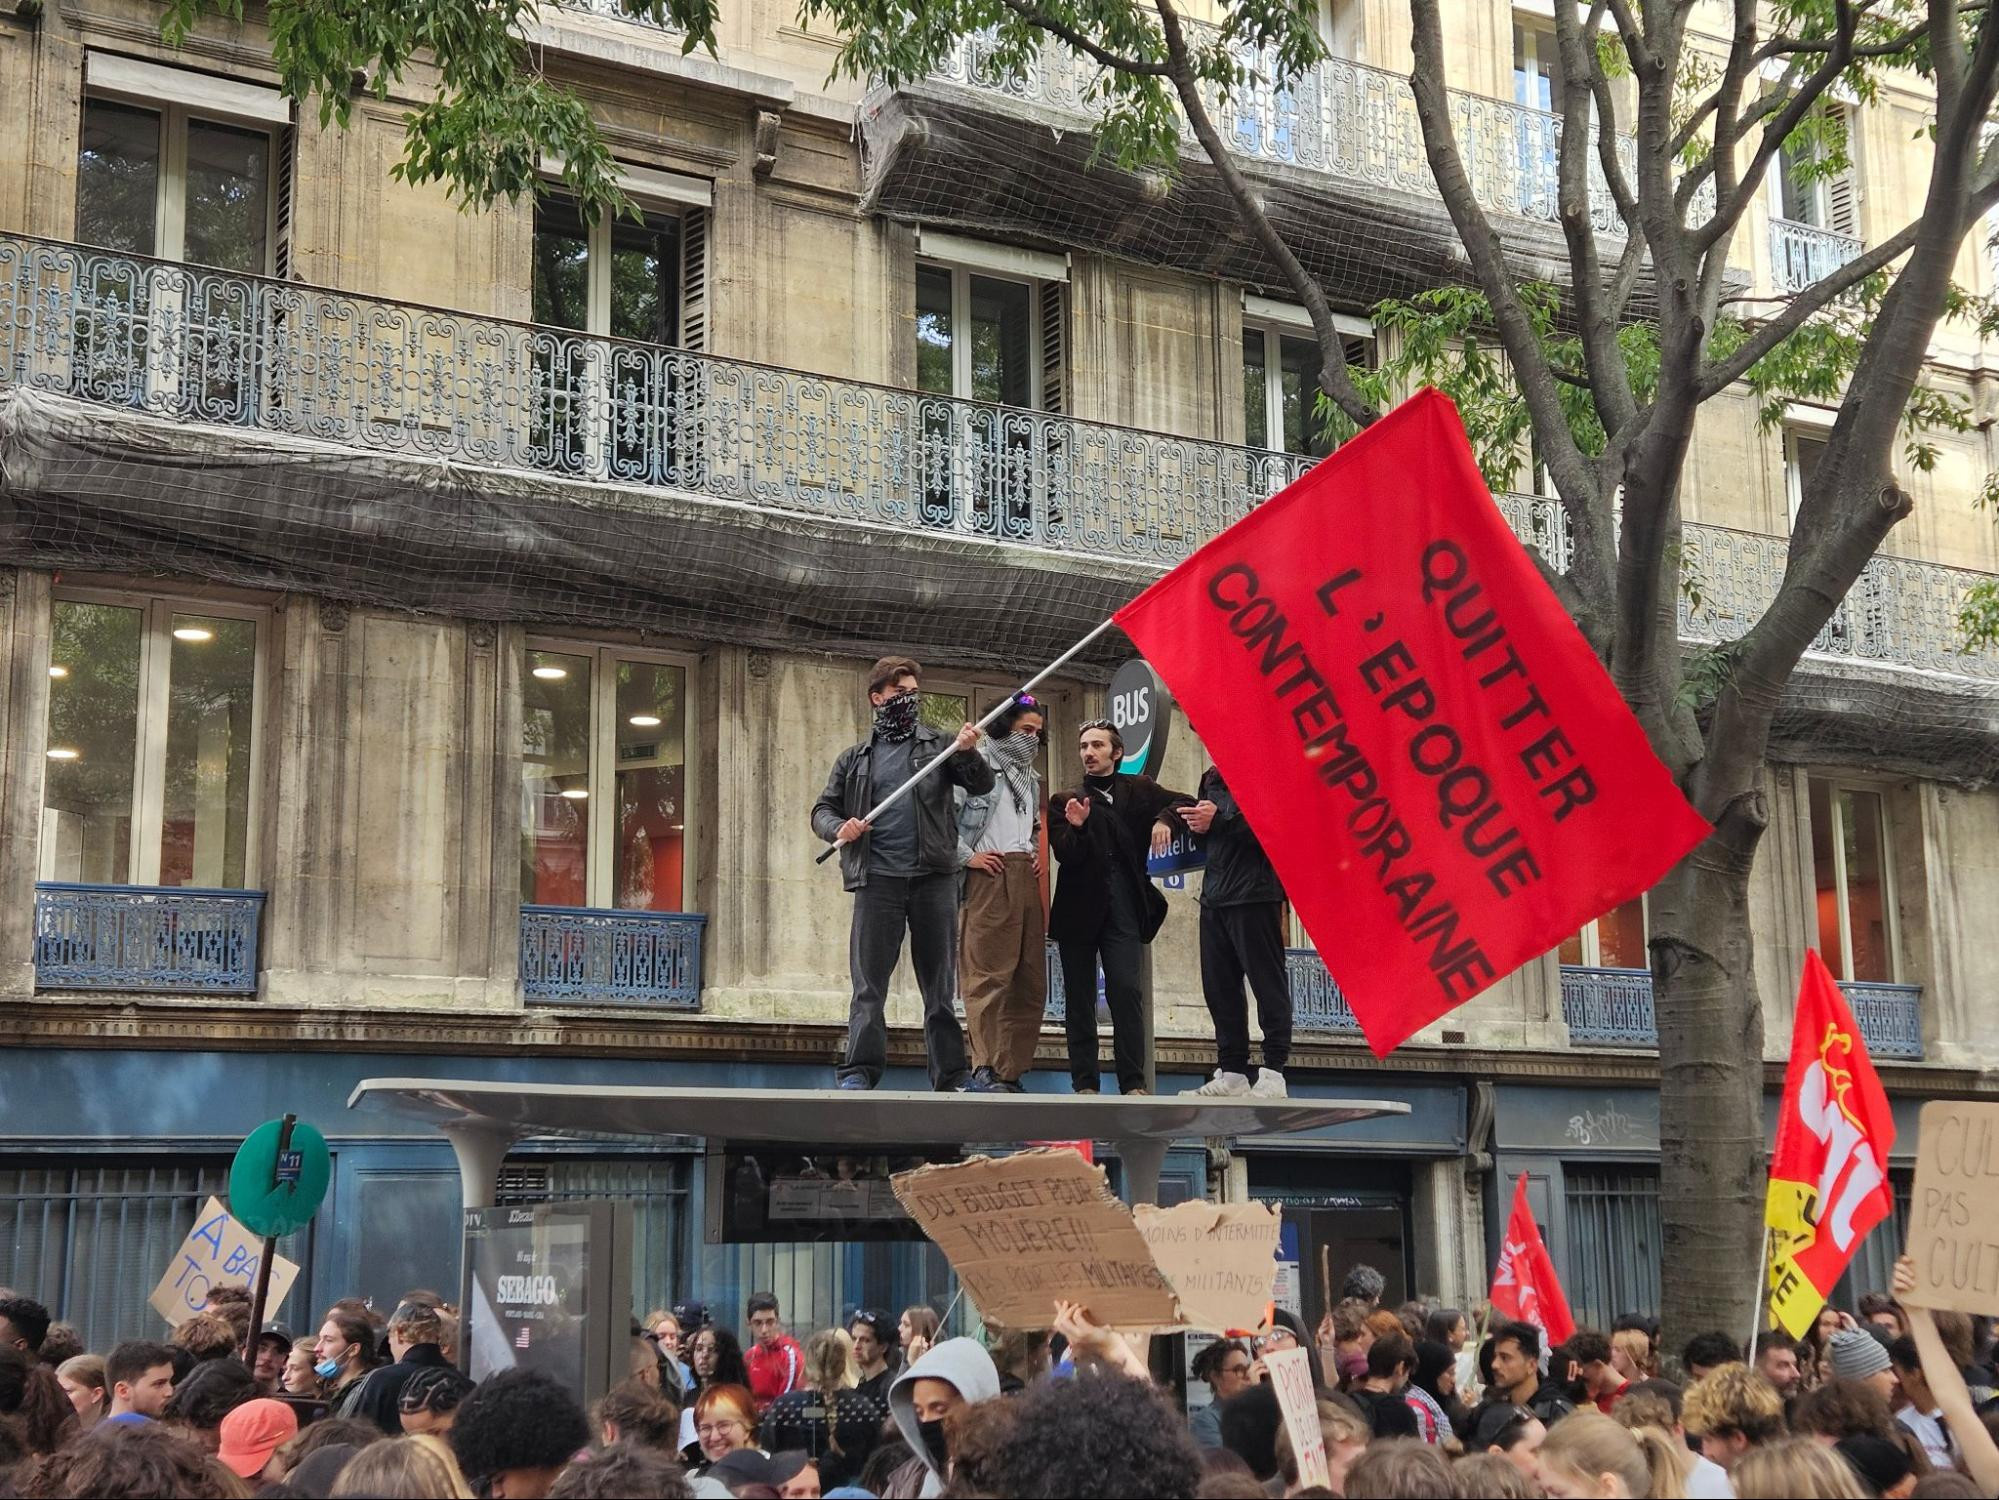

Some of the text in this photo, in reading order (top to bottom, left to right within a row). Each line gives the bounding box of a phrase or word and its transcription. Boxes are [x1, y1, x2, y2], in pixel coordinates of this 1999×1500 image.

[1421, 540, 1597, 822] QUITTER
[1112, 686, 1150, 730] BUS
[1208, 565, 1496, 997] CONTEMPORAINE
[288, 1154, 301, 1168] 11
[916, 1177, 1097, 1221] DU BUDGET POUR
[1923, 1187, 1971, 1229] PAS
[496, 1274, 557, 1306] SEBAGO
